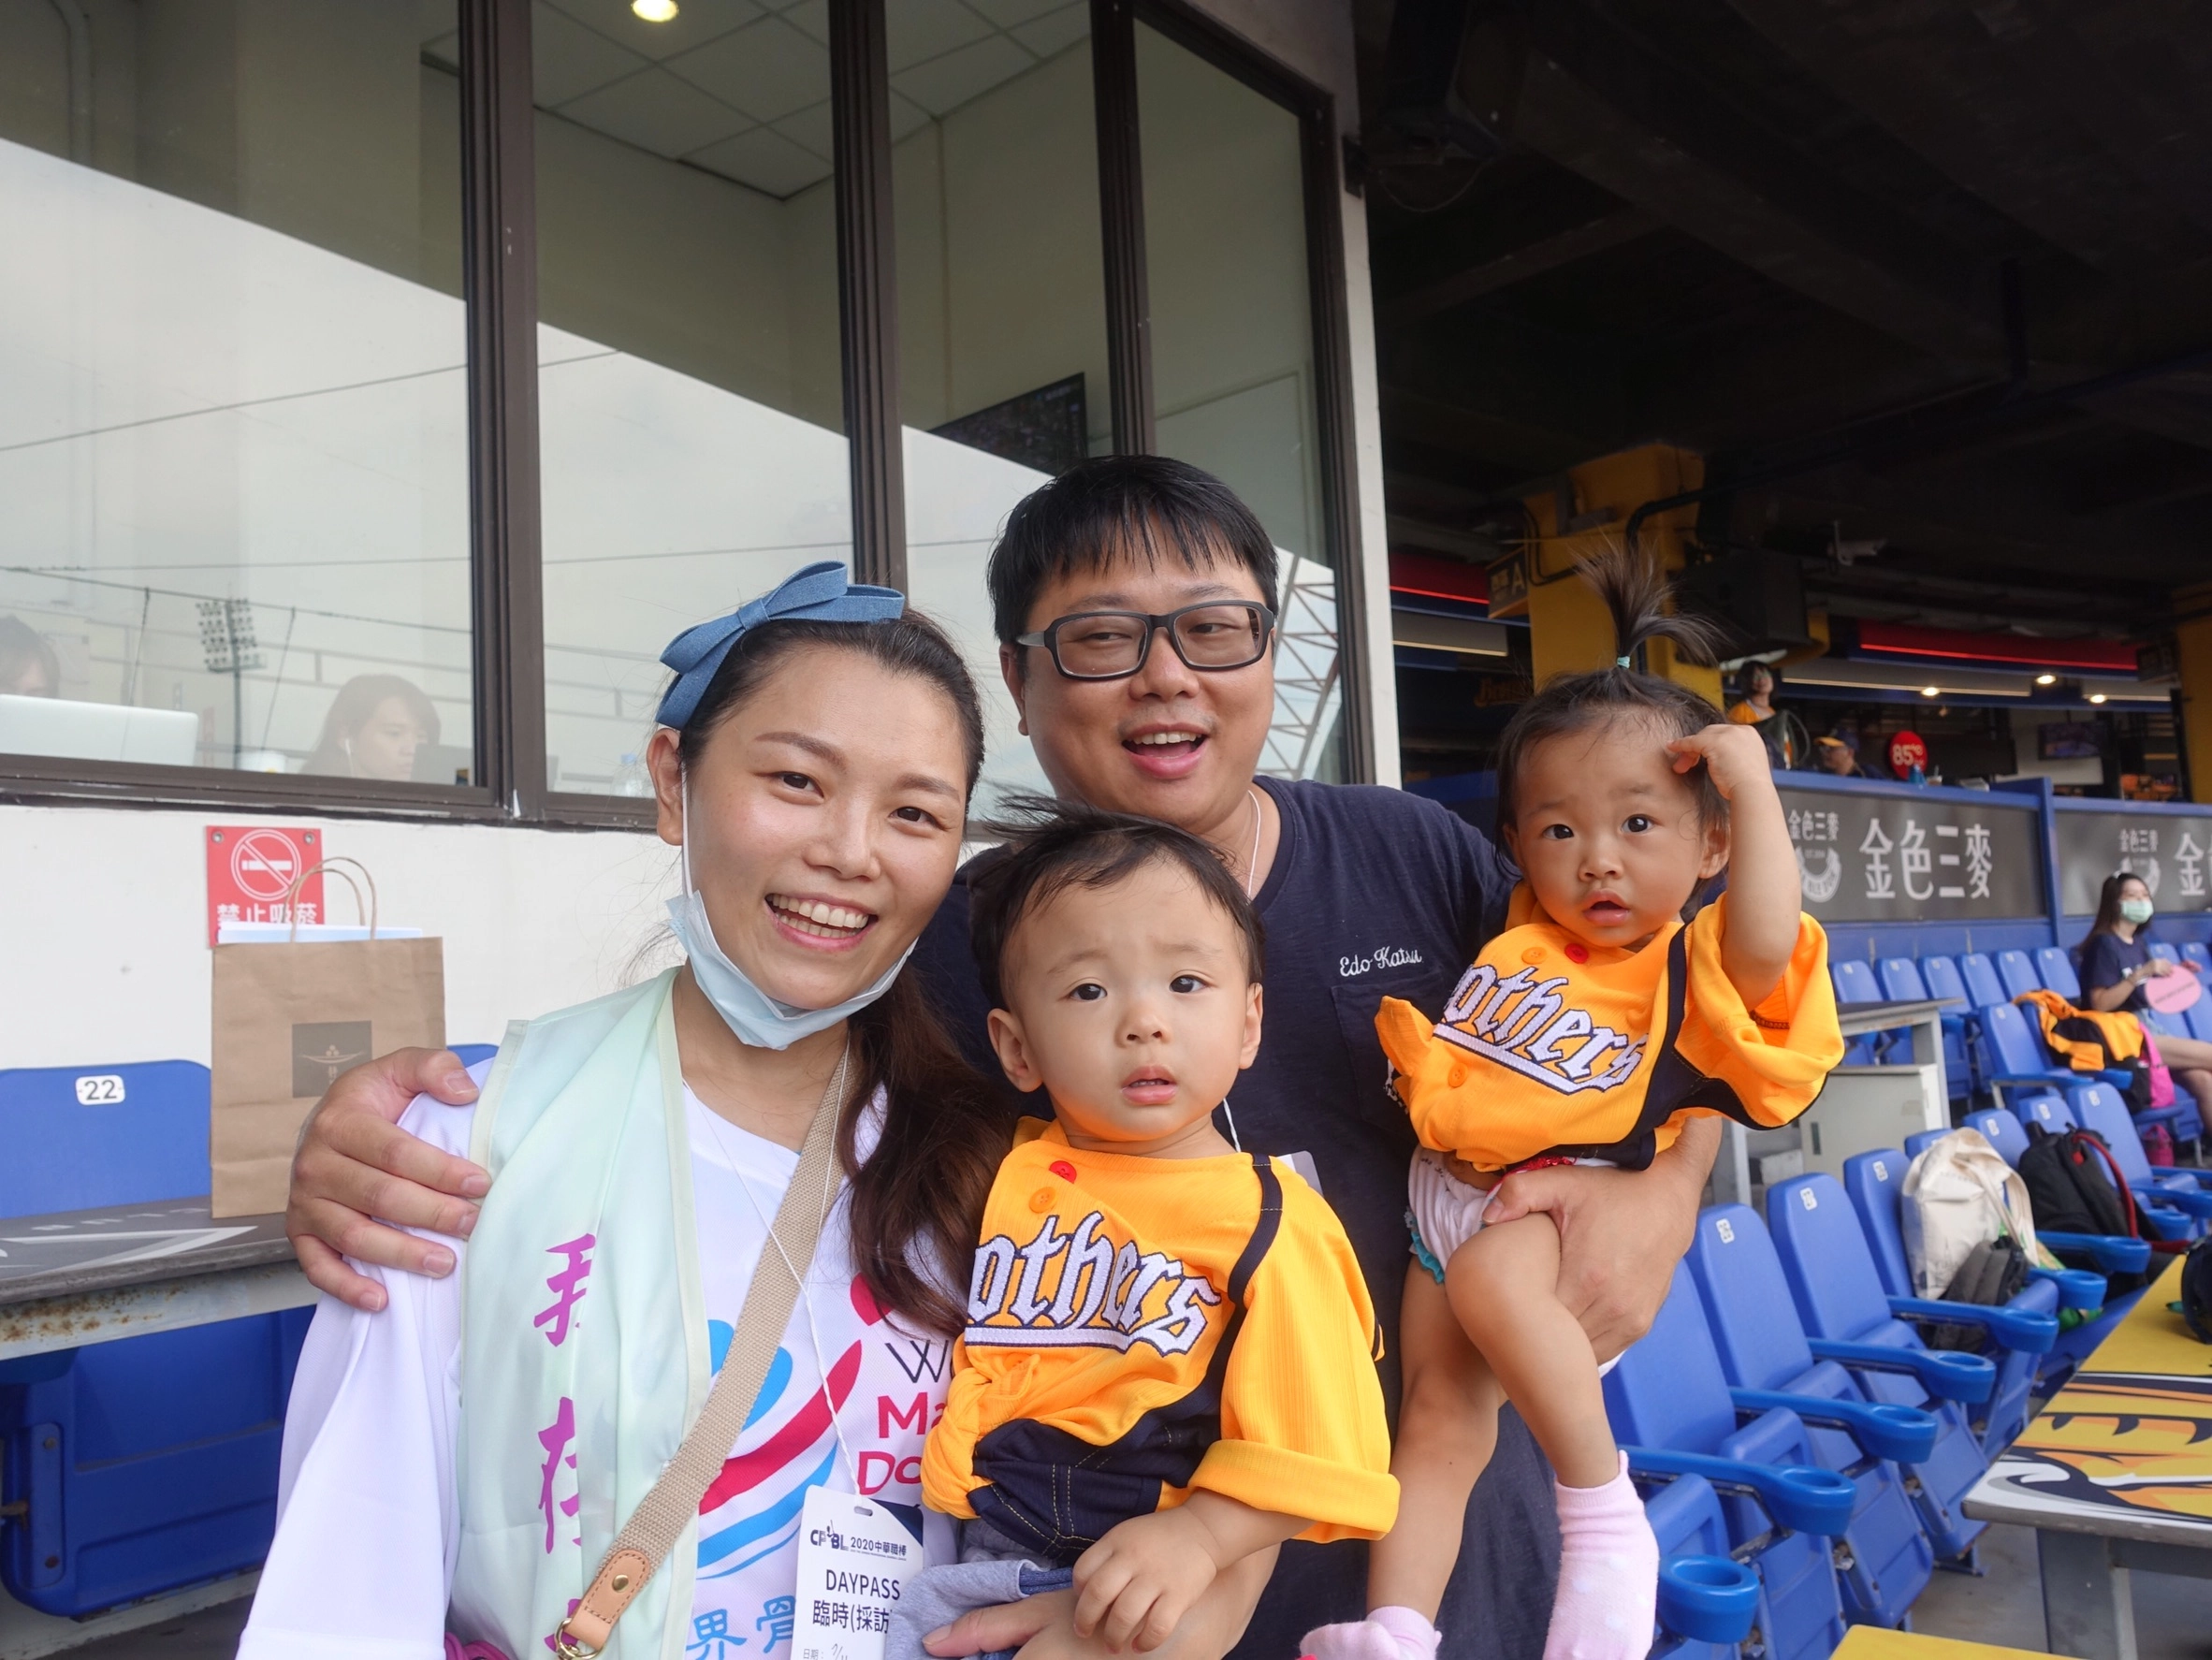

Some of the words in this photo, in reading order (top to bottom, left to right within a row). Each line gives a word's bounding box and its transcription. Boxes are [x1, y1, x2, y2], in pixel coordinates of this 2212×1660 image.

[1788, 809, 1840, 841] 金色三麥
[1859, 818, 1992, 899] 金色三麥
[2174, 832, 2212, 896] 金
[1339, 954, 1373, 977] Edo
[1374, 945, 1422, 969] Katsu
[84, 1079, 117, 1100] 22
[825, 1568, 901, 1601] DAYPASS
[812, 1599, 893, 1634] 臨時(採訪
